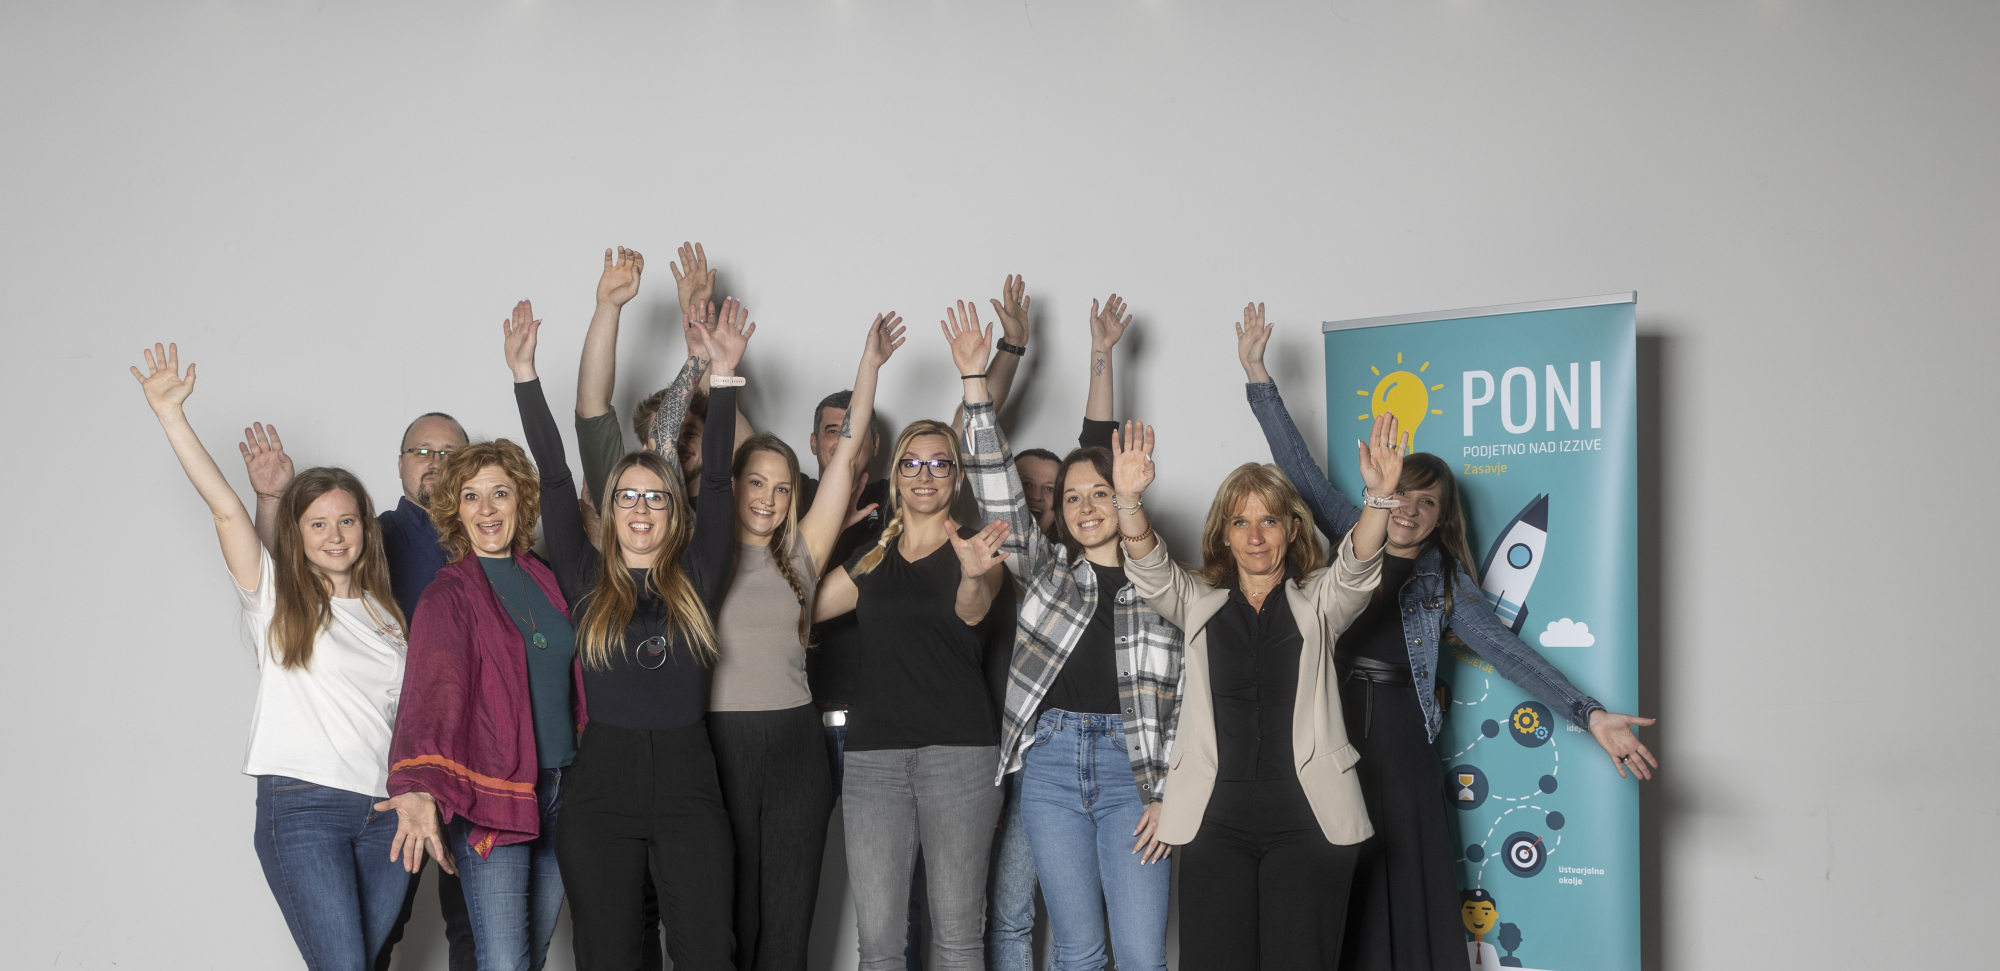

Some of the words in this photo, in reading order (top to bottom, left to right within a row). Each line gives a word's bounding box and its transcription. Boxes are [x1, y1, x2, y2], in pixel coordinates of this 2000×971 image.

[1463, 361, 1601, 436] PONI
[1463, 443, 1526, 459] PODJETNO
[1529, 441, 1556, 454] NAD
[1559, 438, 1602, 452] IZZIVE
[1463, 462, 1507, 475] Zasavje
[1450, 647, 1494, 674] PODJETJE
[1558, 865, 1605, 876] Ustvarjalno
[1558, 876, 1583, 886] okolje
